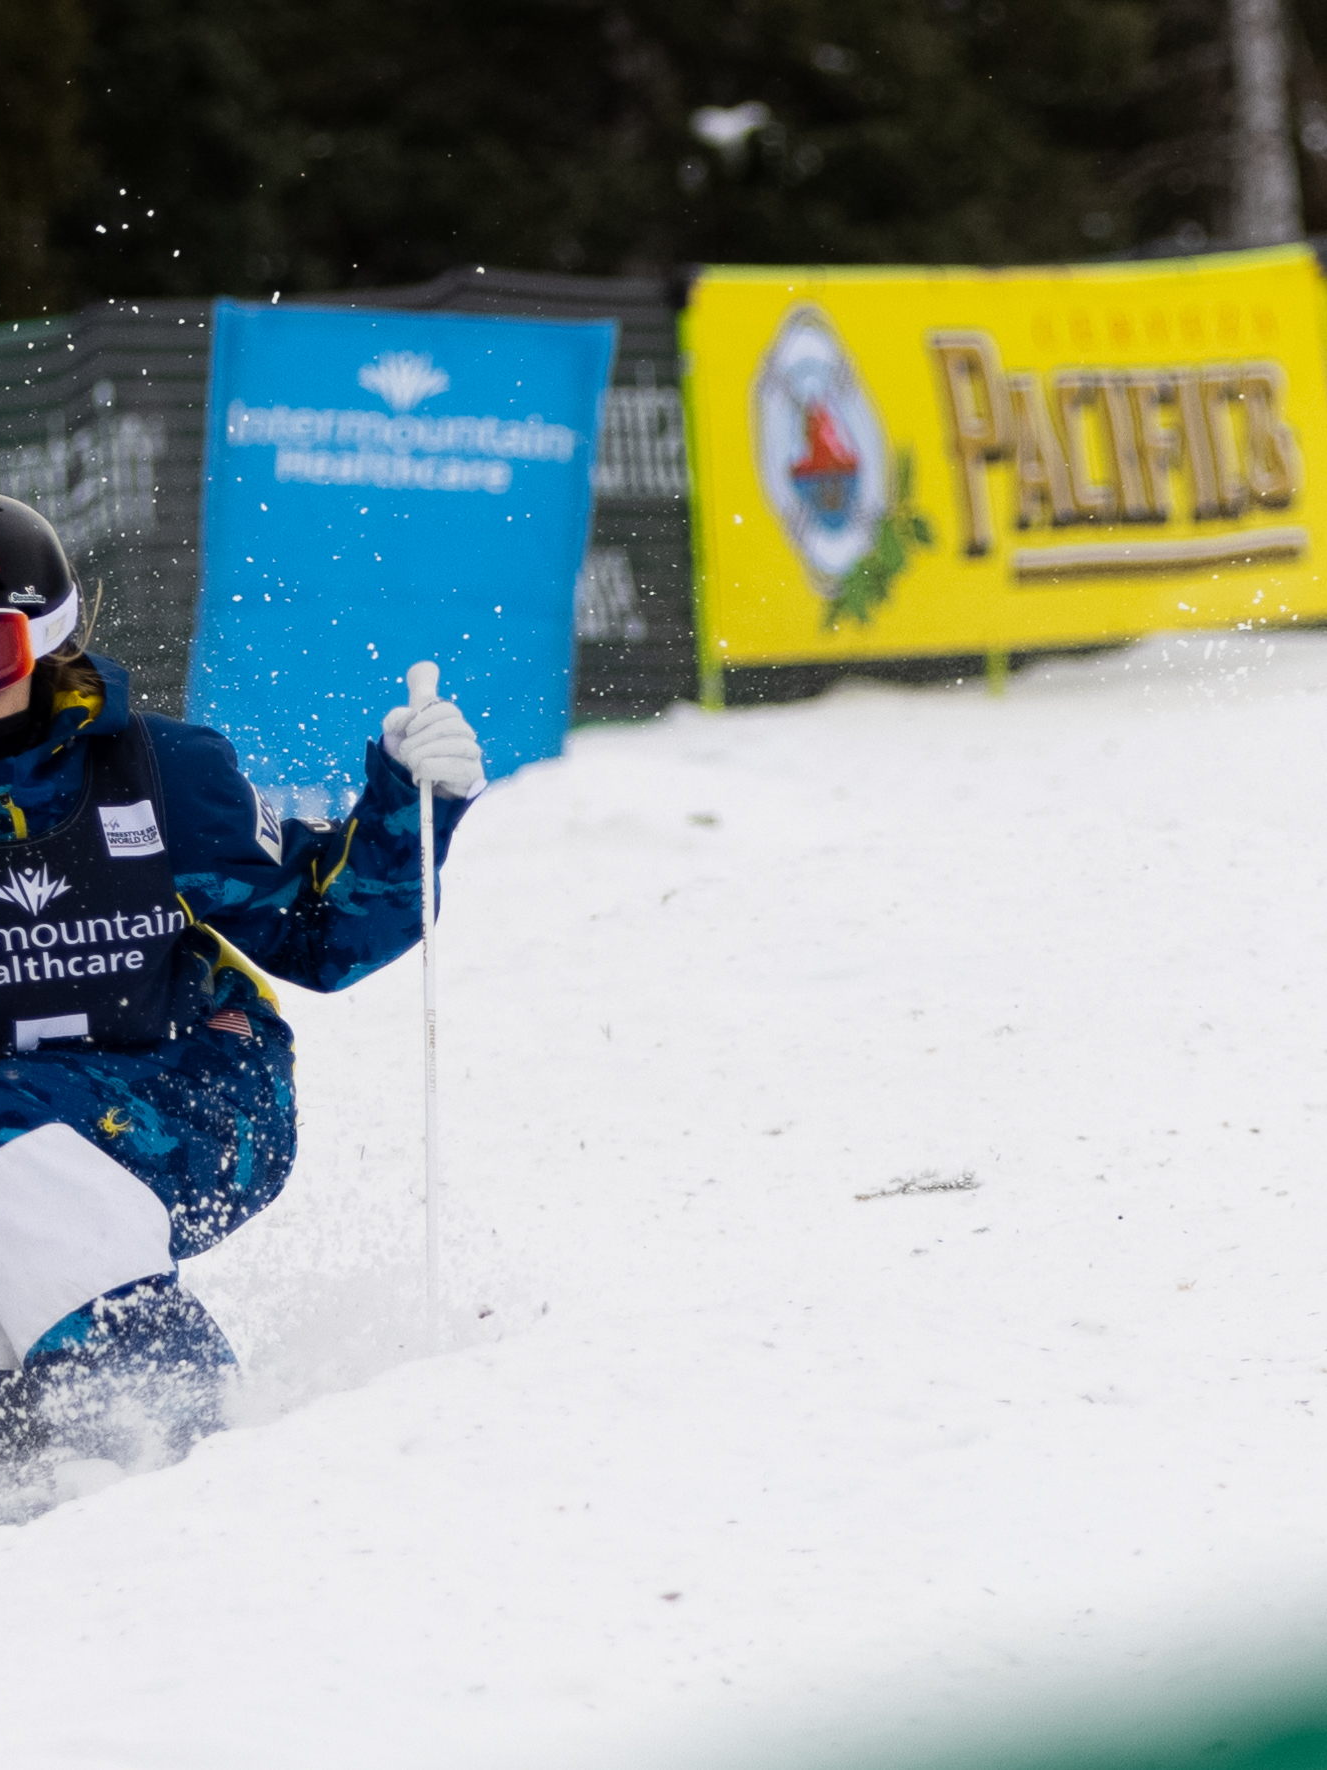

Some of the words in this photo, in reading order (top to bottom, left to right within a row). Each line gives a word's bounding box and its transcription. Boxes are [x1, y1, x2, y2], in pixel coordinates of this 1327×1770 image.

[106, 829, 145, 838] FREESTYLE
[108, 836, 141, 845] WORLD
[142, 830, 158, 843] CUP
